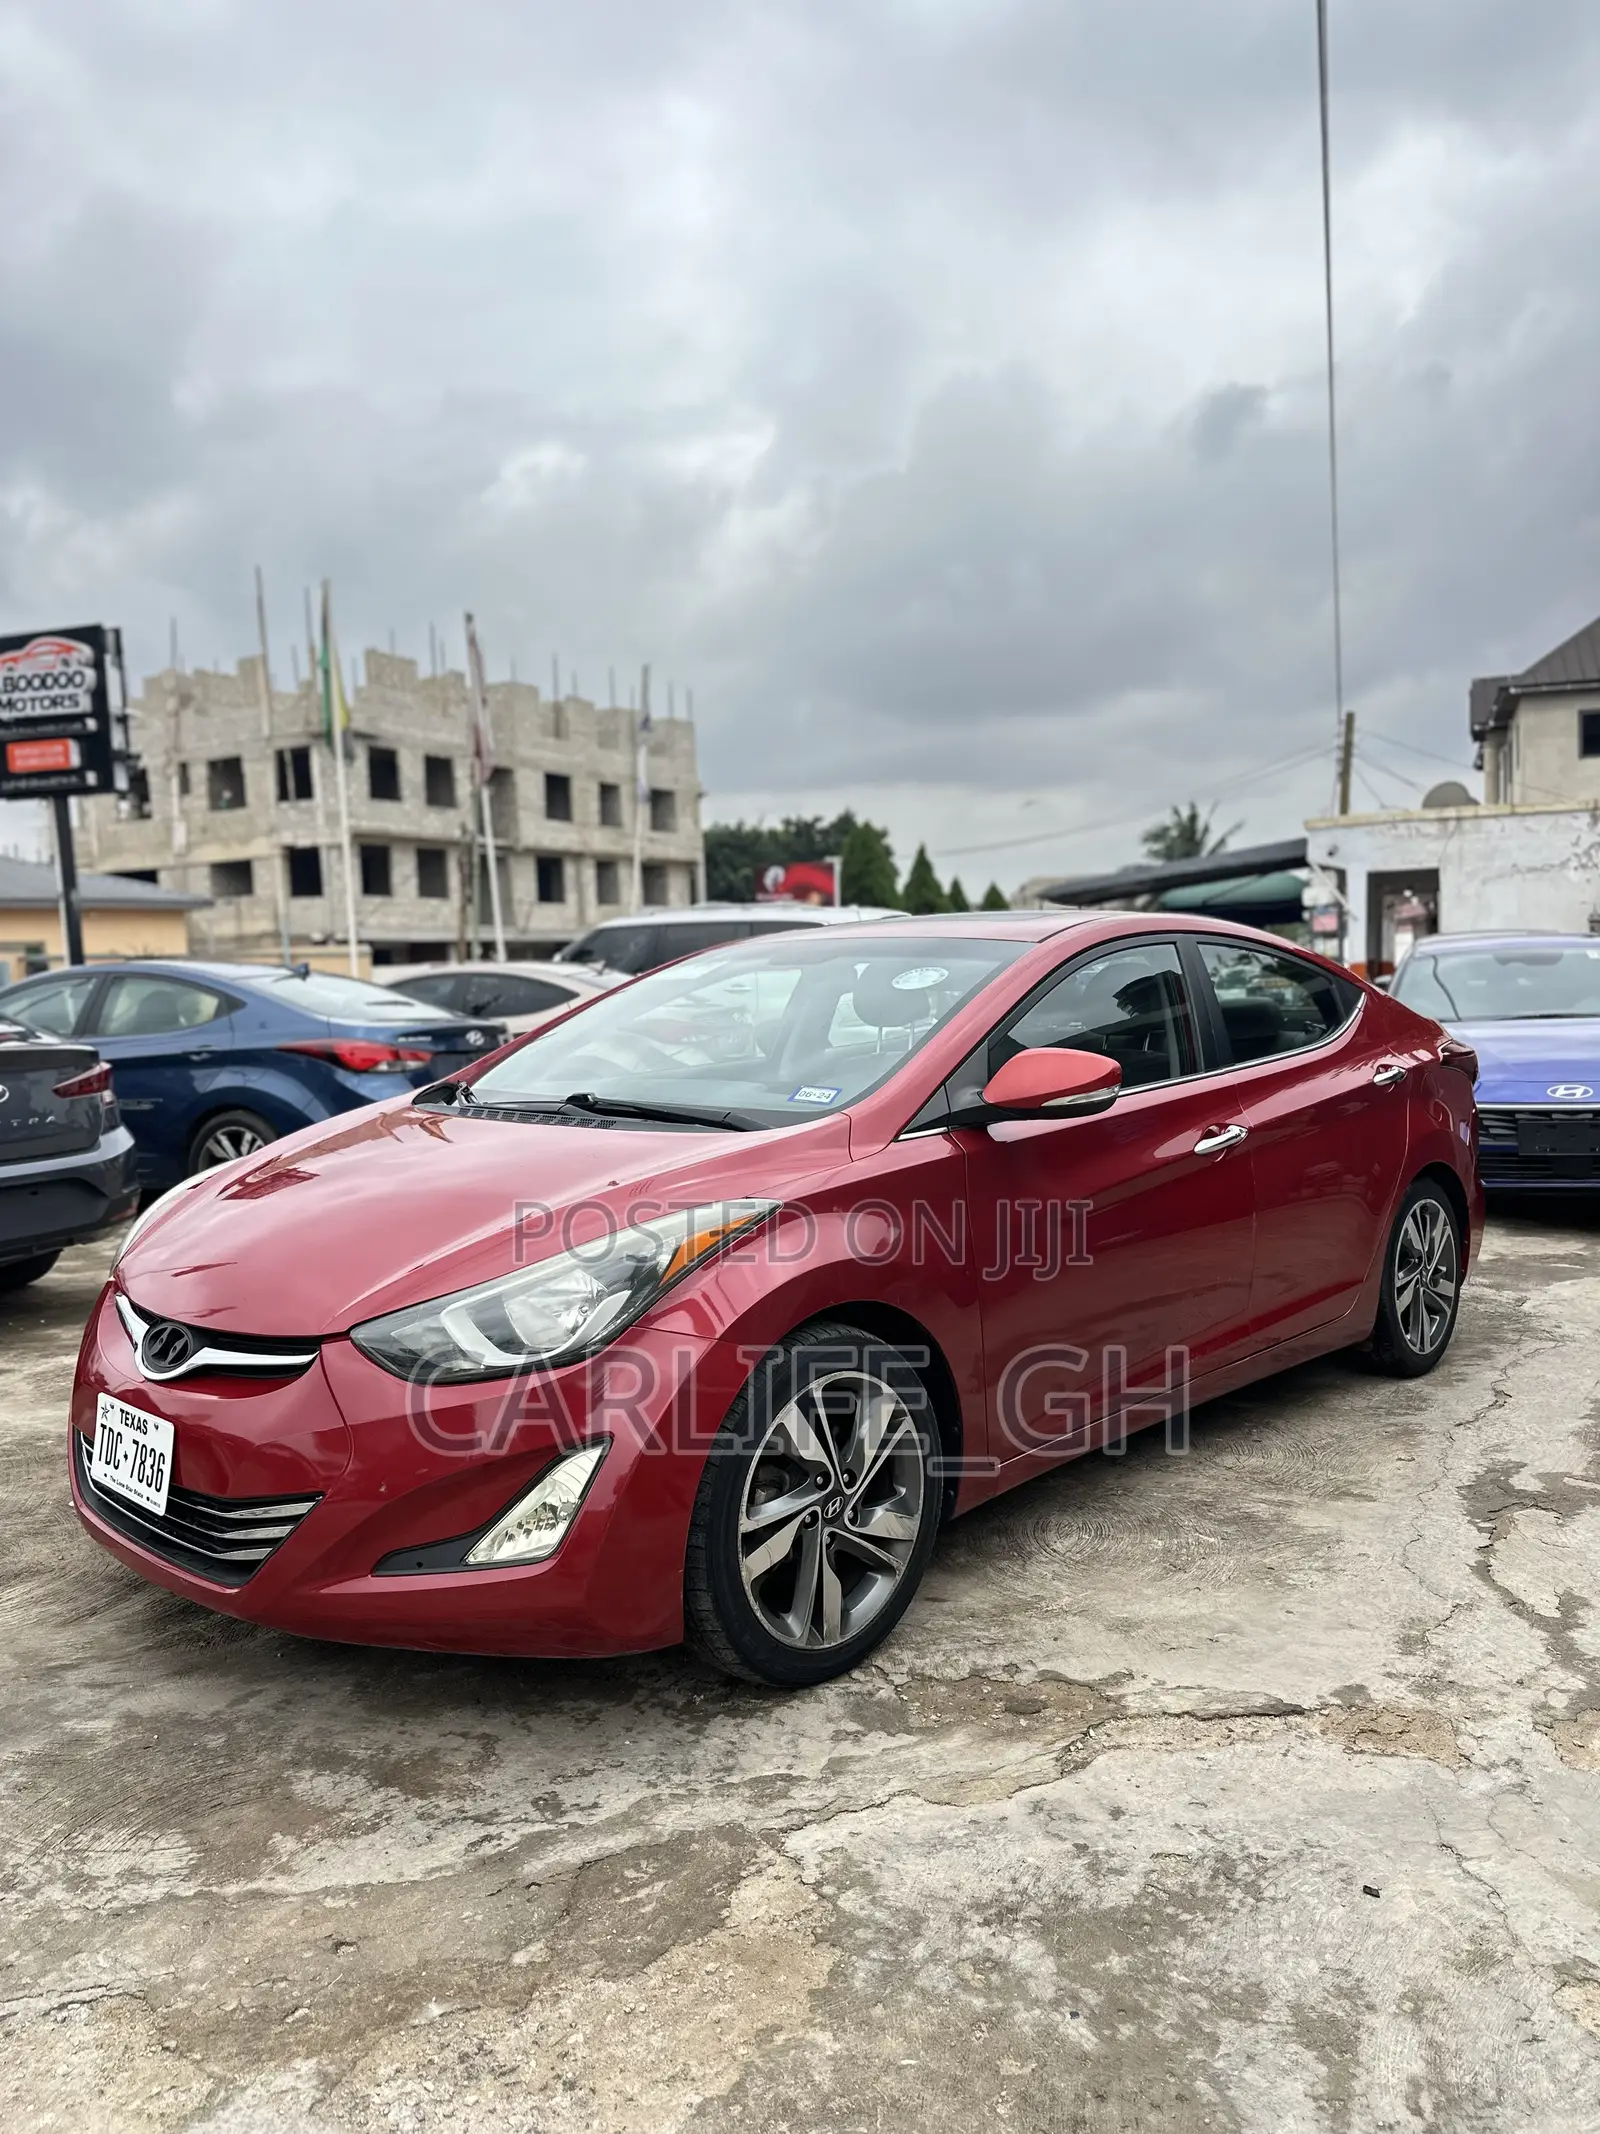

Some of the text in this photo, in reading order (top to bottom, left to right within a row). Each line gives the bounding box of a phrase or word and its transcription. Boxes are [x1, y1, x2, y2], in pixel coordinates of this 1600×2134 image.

[0, 670, 85, 693] BOODOO
[0, 694, 79, 712] MOTORS
[0, 1115, 56, 1126] TRA
[120, 1408, 148, 1435] TEXAS
